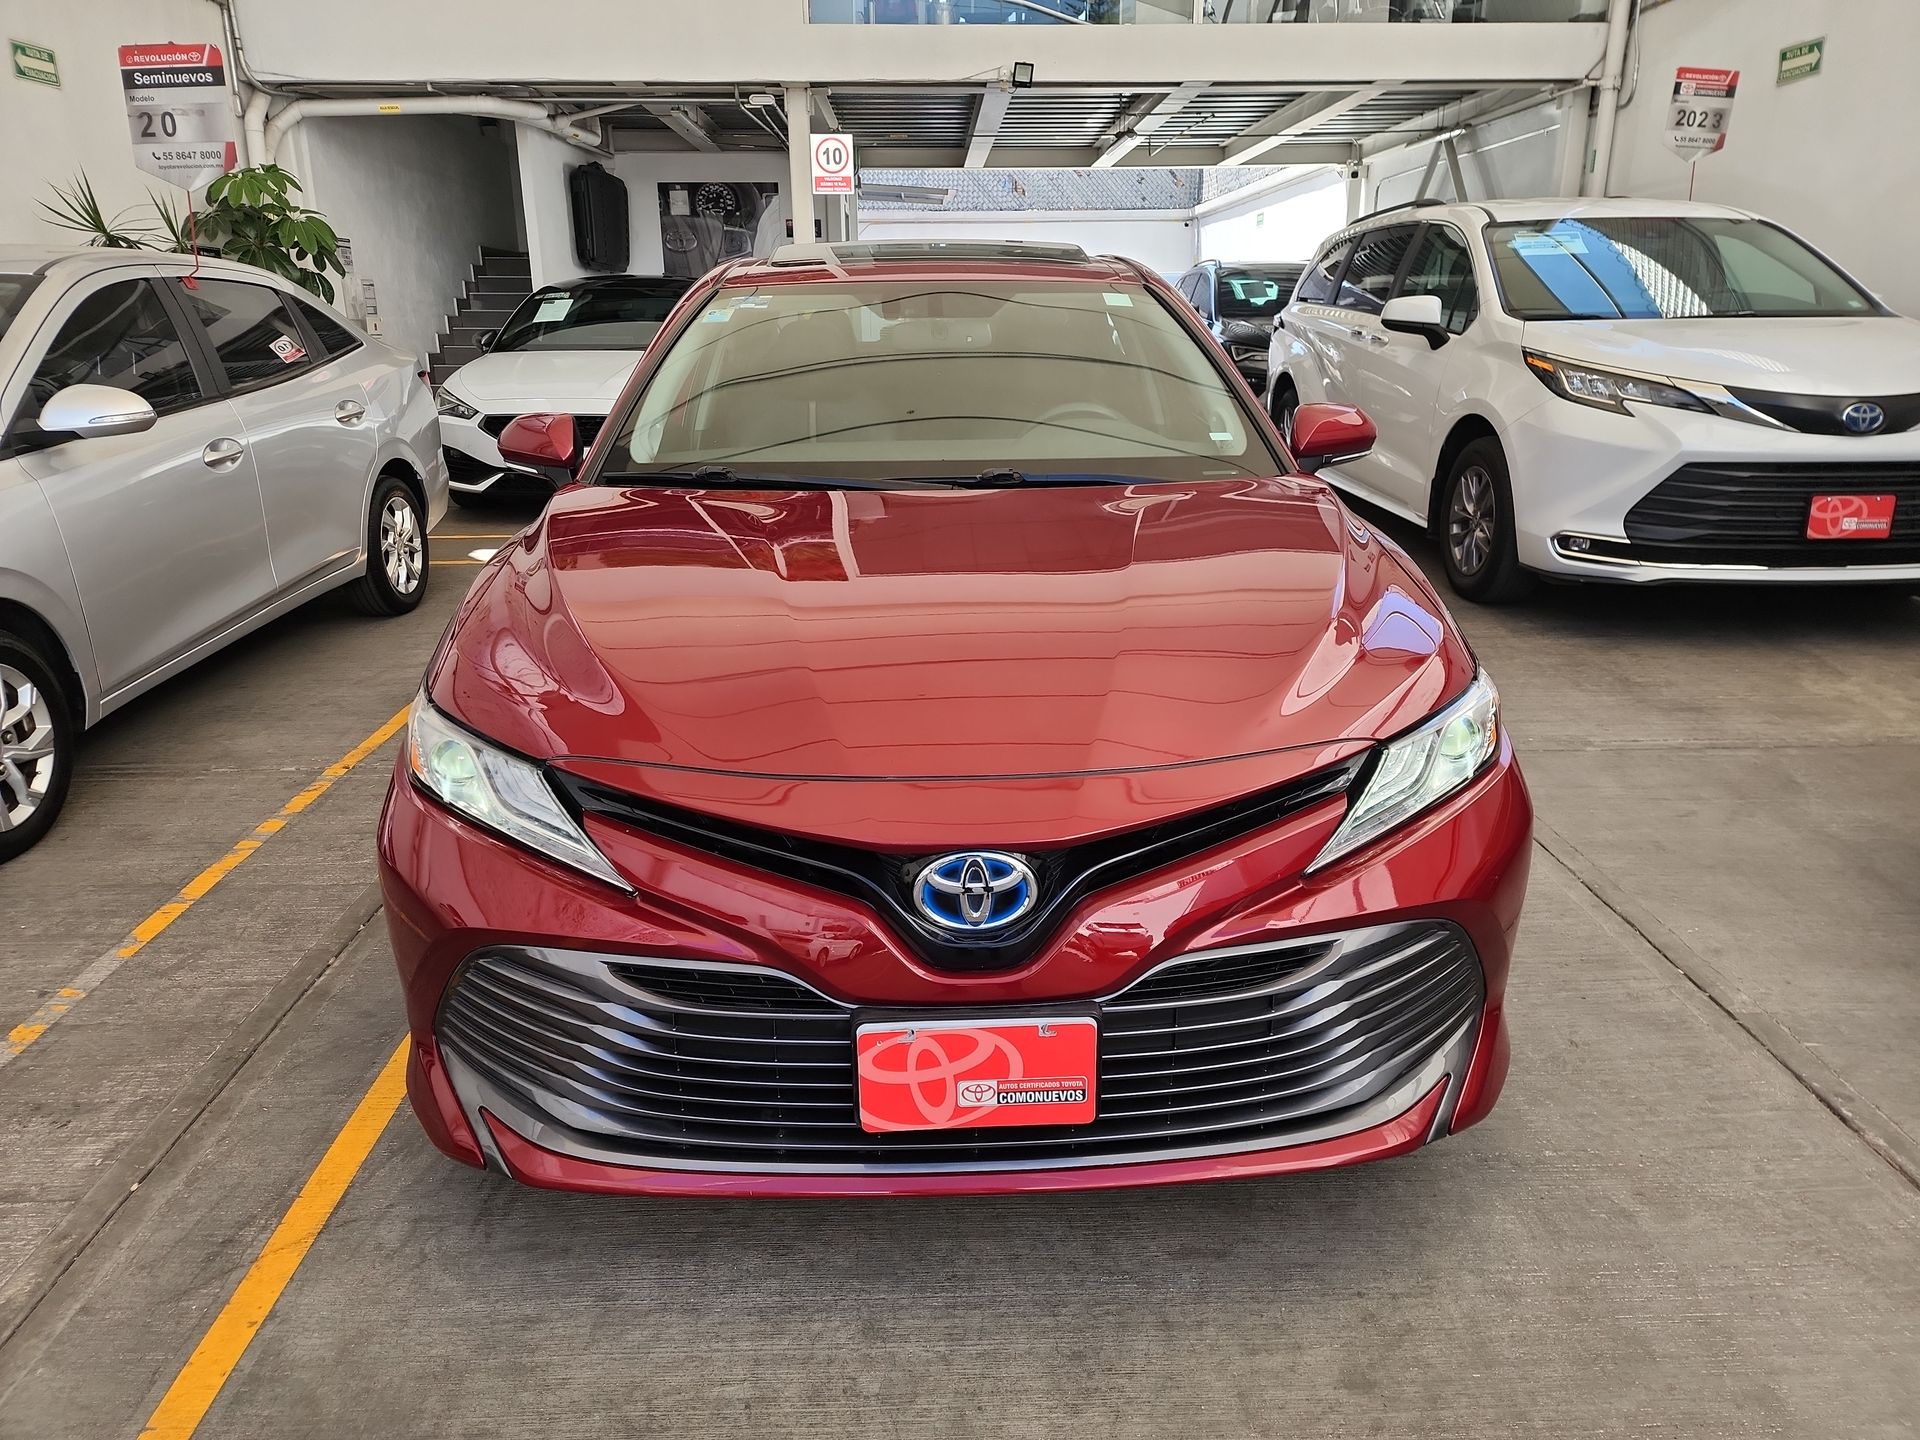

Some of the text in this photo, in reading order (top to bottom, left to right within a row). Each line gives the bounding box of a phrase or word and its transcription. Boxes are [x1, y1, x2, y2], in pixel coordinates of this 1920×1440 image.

[133, 52, 188, 63] REVOLUCIÓN
[133, 71, 213, 85] Seminuevos
[129, 94, 155, 103] Modelo
[1675, 109, 1723, 129] 2023
[162, 150, 222, 161] 55 8647 8000
[823, 148, 842, 165] 10
[999, 1082, 1018, 1090] AUTOS
[1019, 1081, 1061, 1089] CERTIFICADOS
[1000, 1090, 1083, 1103] COMONUEVOS
